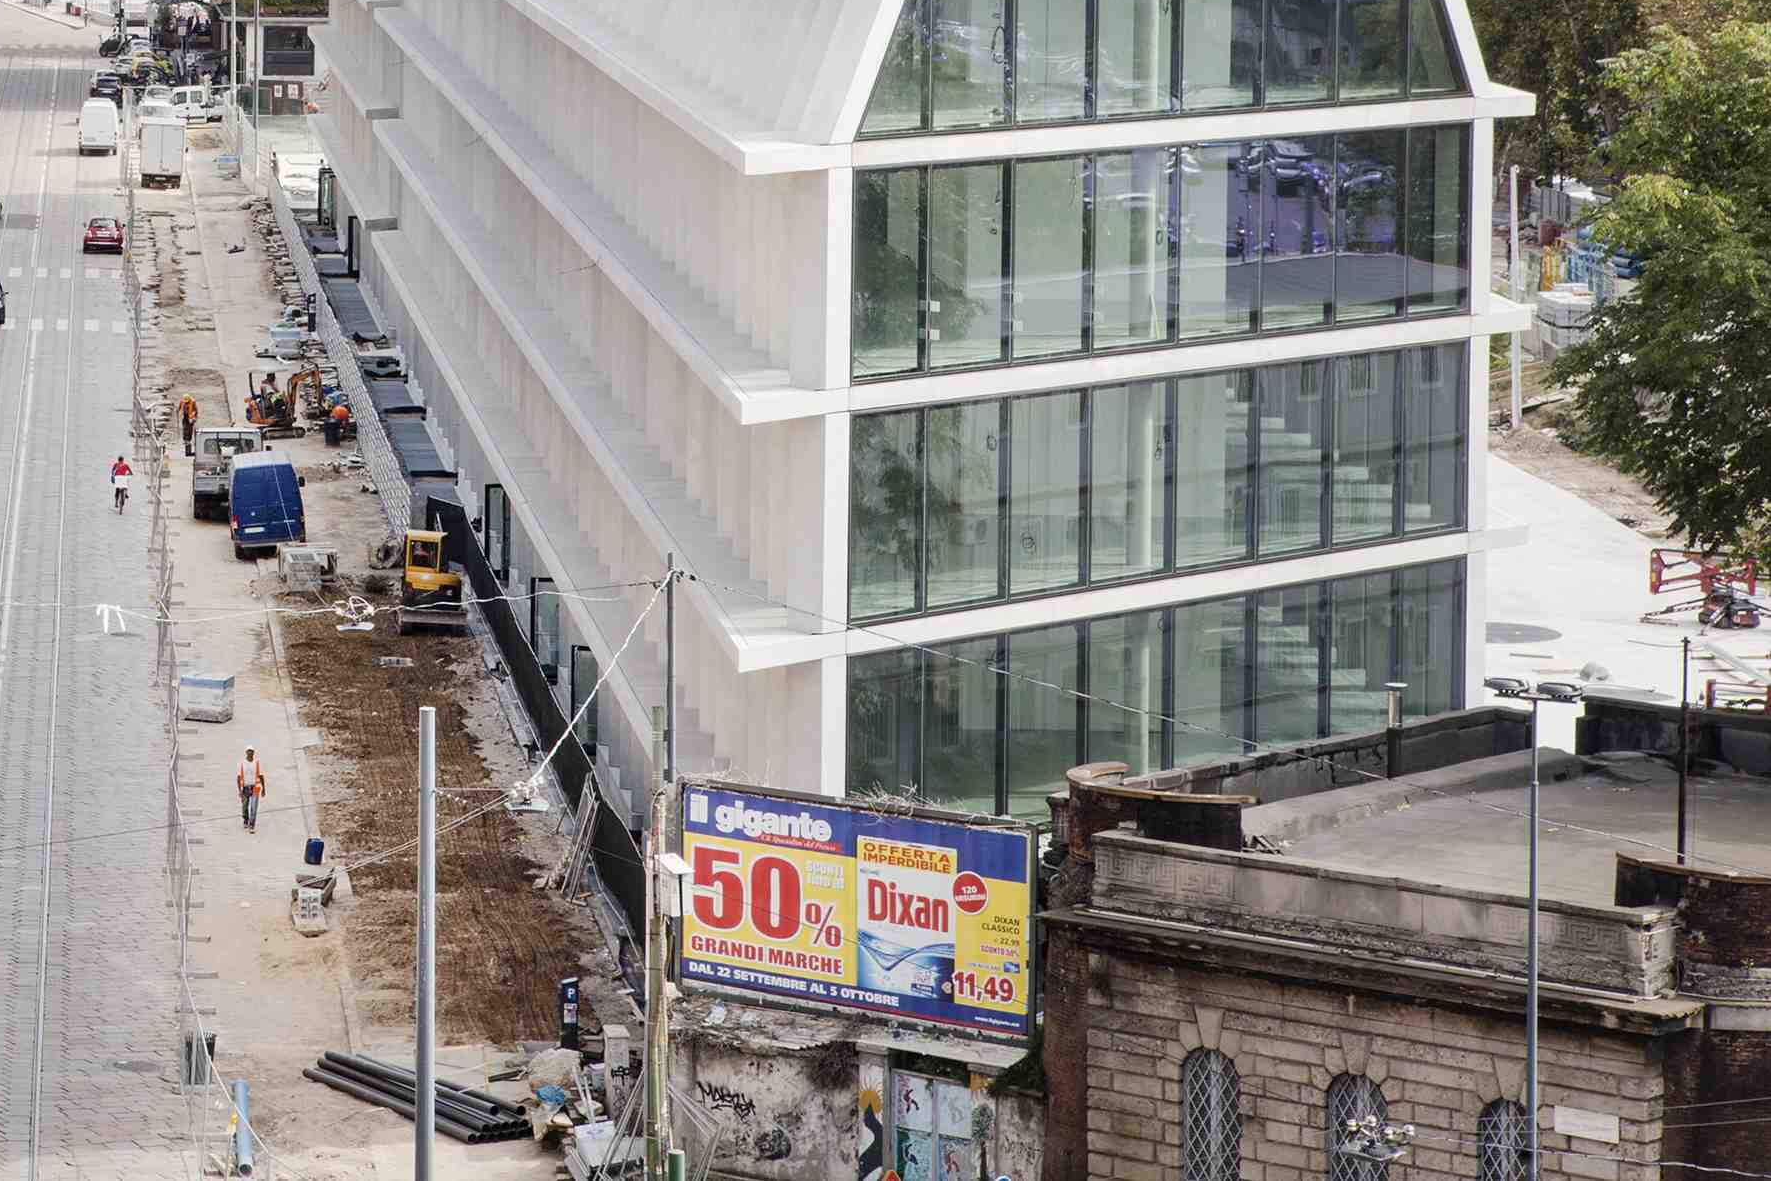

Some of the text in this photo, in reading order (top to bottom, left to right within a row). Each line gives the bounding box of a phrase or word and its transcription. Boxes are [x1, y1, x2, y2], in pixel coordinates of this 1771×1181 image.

[690, 793, 832, 841] il gigante
[863, 842, 951, 864] OFFERTA
[863, 852, 951, 874] IMPERDIBILE
[868, 878, 949, 932] Dixan
[994, 915, 1020, 926] DIXAN
[981, 922, 1020, 935] CLASSICO
[691, 935, 843, 975] GRANDI MARCHE
[689, 961, 899, 1007] DAL 22 SETTEMBRE AL 5 OTTOBRE
[954, 971, 1014, 1002] 11,49
